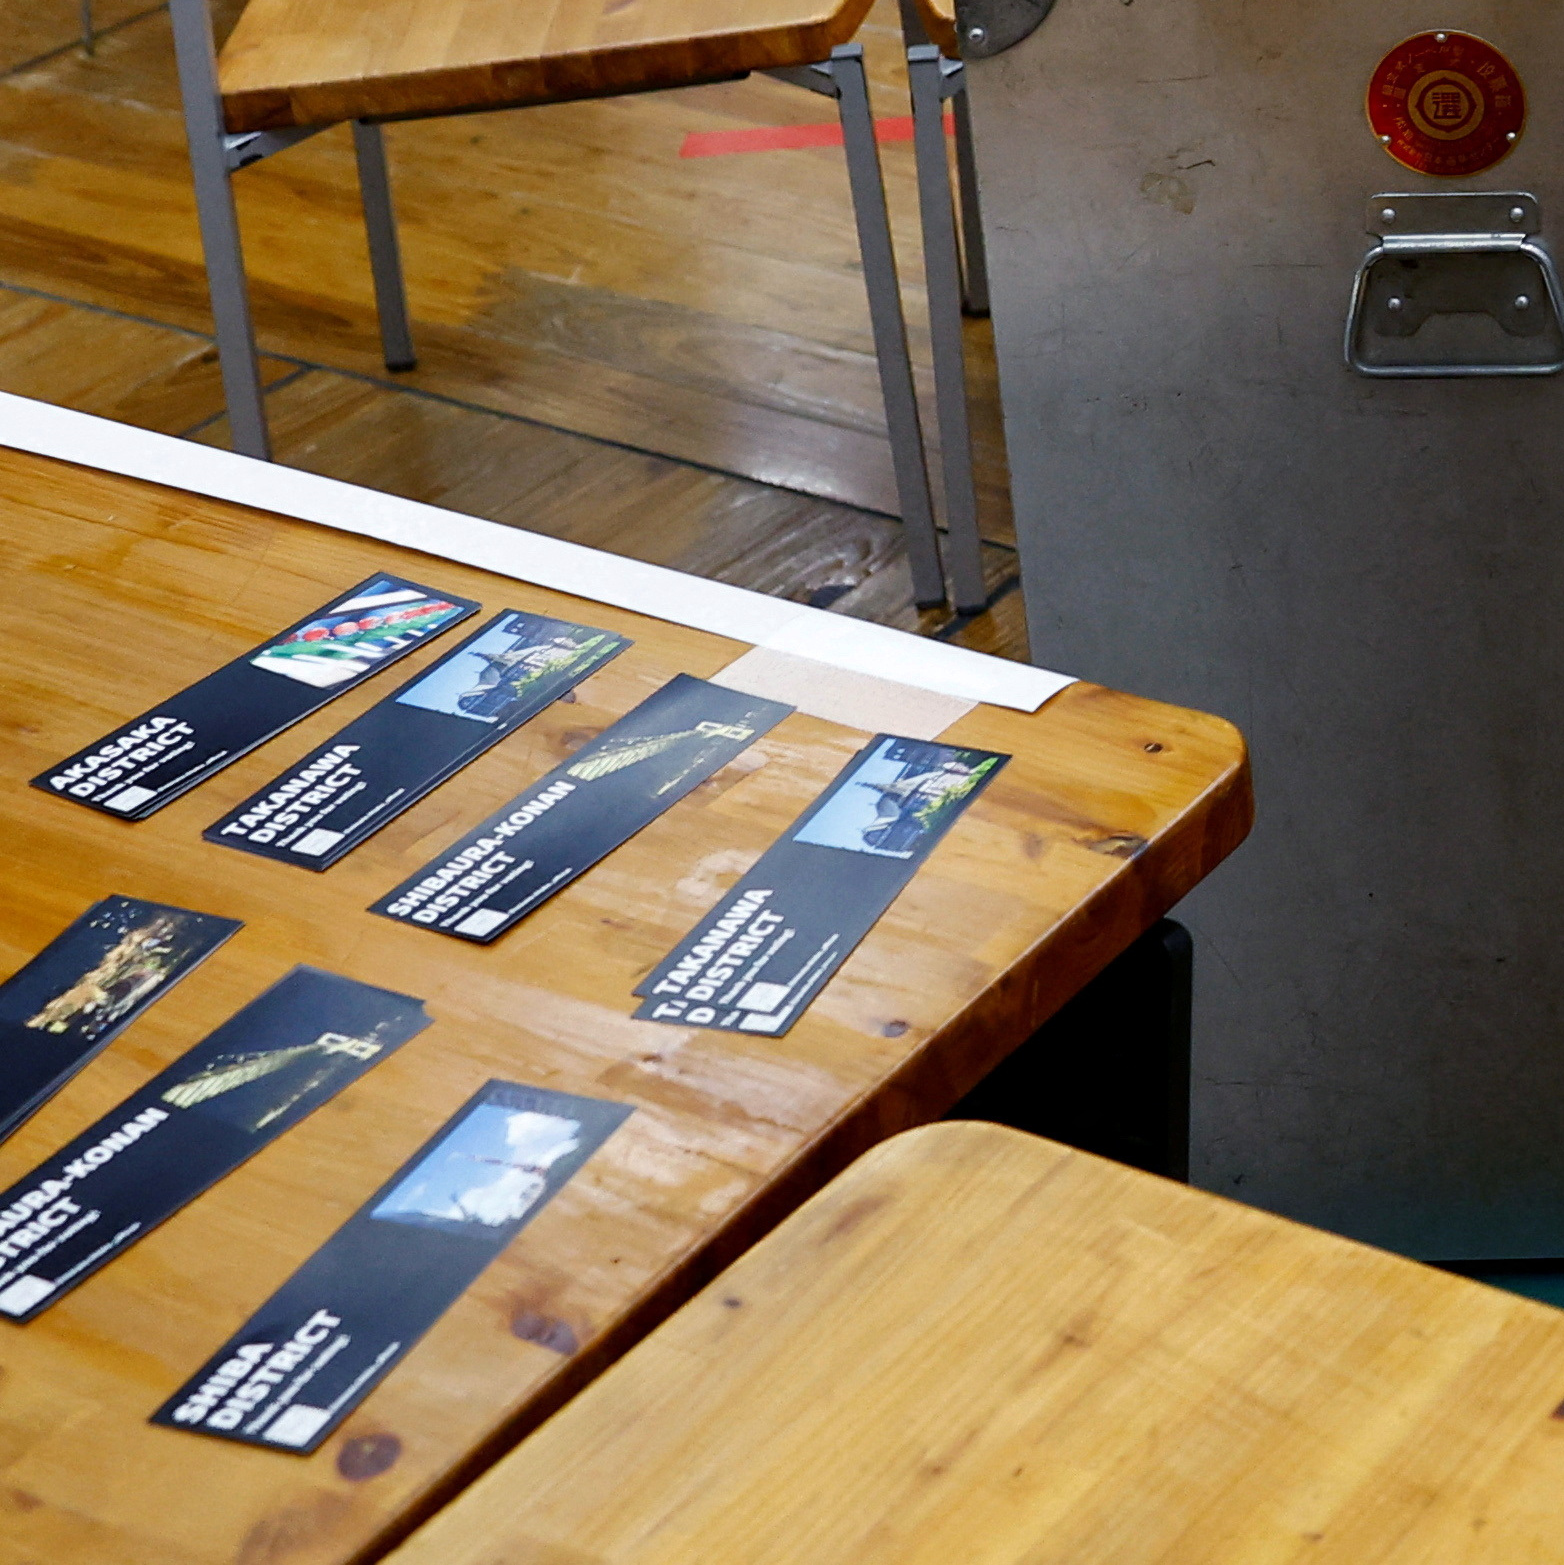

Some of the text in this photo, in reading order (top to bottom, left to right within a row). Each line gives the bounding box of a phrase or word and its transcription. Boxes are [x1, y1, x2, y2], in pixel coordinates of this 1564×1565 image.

[50, 716, 177, 790] AKASAKA
[69, 722, 194, 797] DISTRICT
[220, 745, 361, 835] TAKANAWA
[248, 763, 362, 843] DISTRICT
[387, 781, 576, 916] SHIBAURA-KONAN
[412, 851, 515, 923] DISTRICT
[652, 889, 773, 995] TAKANAWA
[684, 909, 785, 1001] DISTRICT
[0, 1196, 81, 1270] TRICT
[172, 1342, 274, 1424] SHIBA
[206, 1309, 341, 1430] DISTRICT
